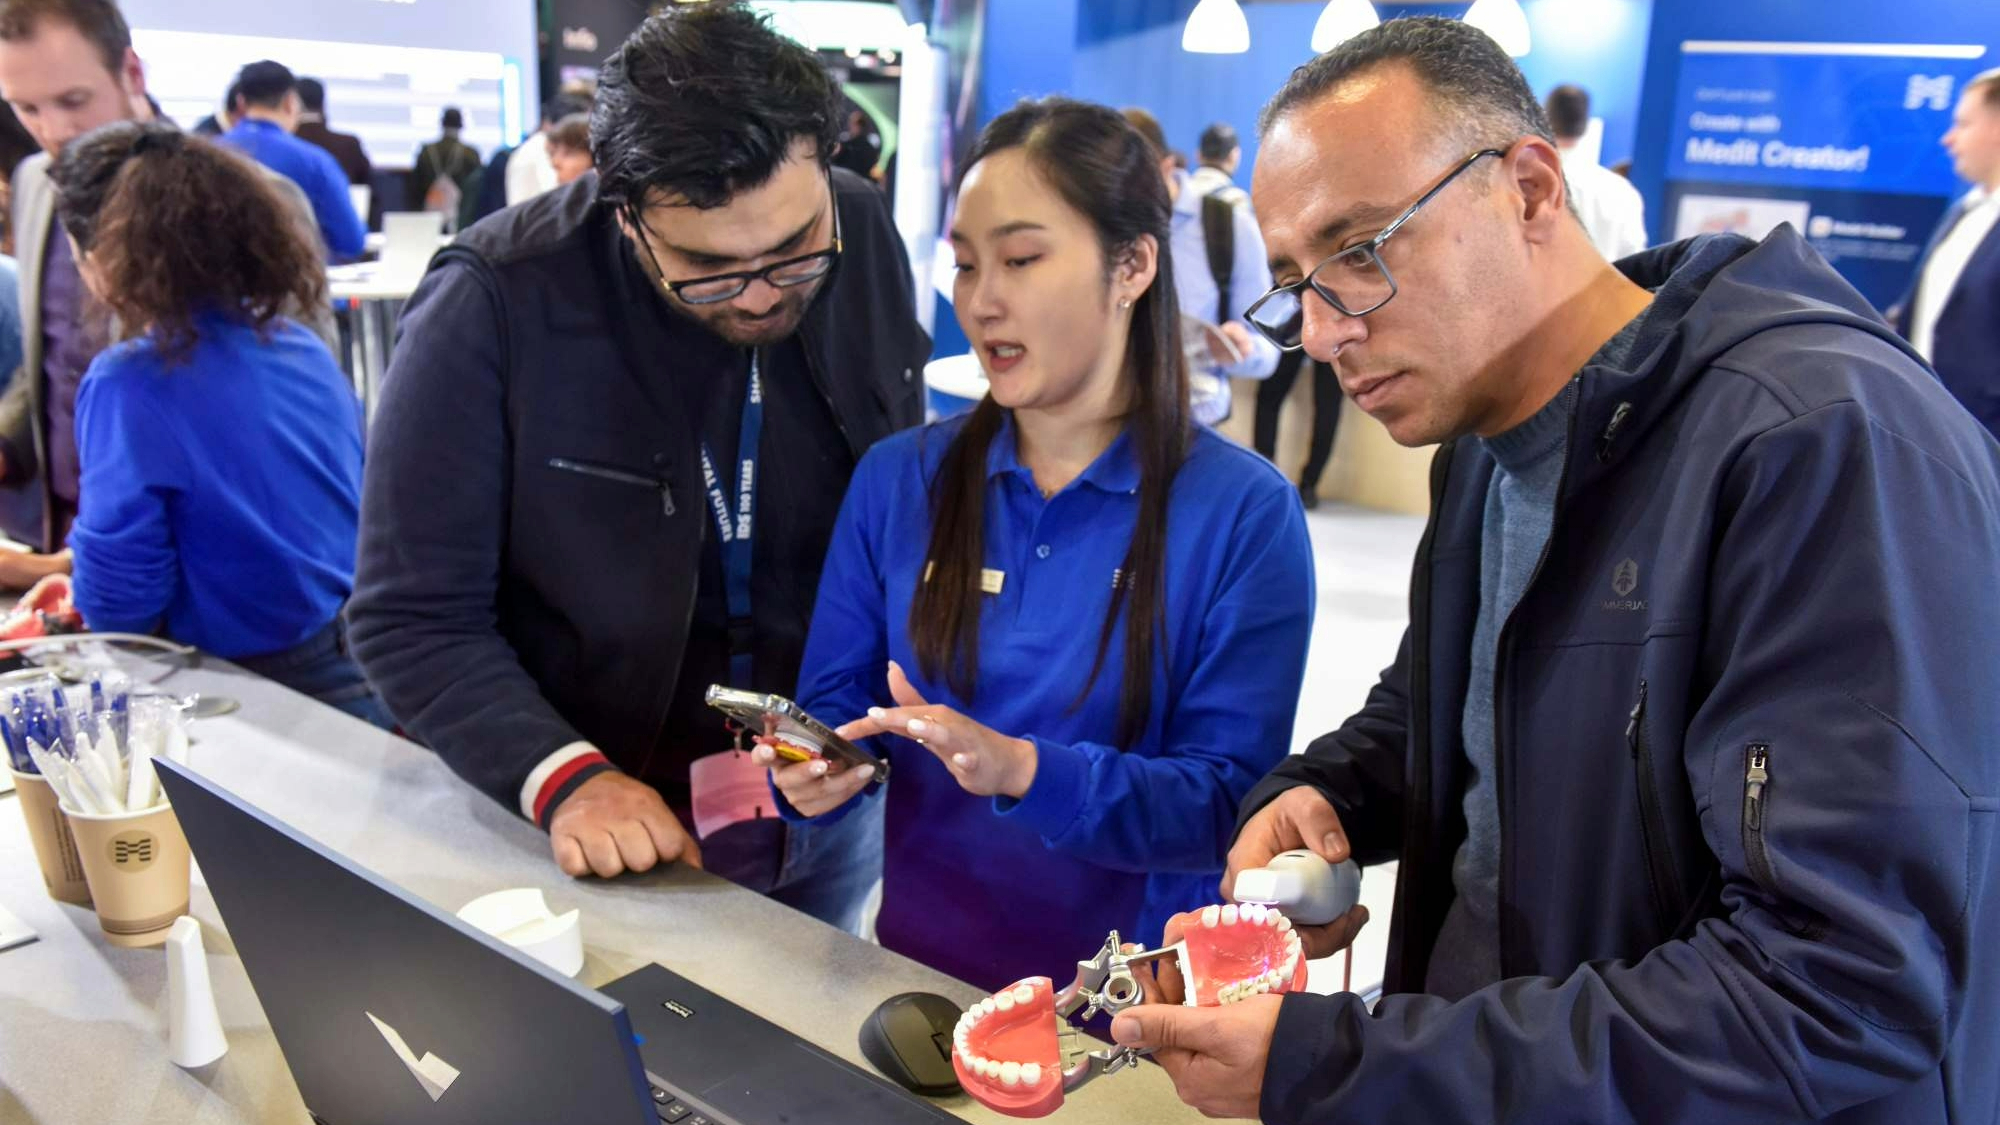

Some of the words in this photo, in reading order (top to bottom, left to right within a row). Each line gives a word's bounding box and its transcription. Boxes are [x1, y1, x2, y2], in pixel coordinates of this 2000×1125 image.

[1691, 112, 1742, 131] Create
[1687, 138, 1758, 166] Medit
[740, 459, 754, 493] YEARS
[710, 488, 733, 543] FUTURE
[739, 493, 752, 512] 100
[736, 513, 752, 539] IDS
